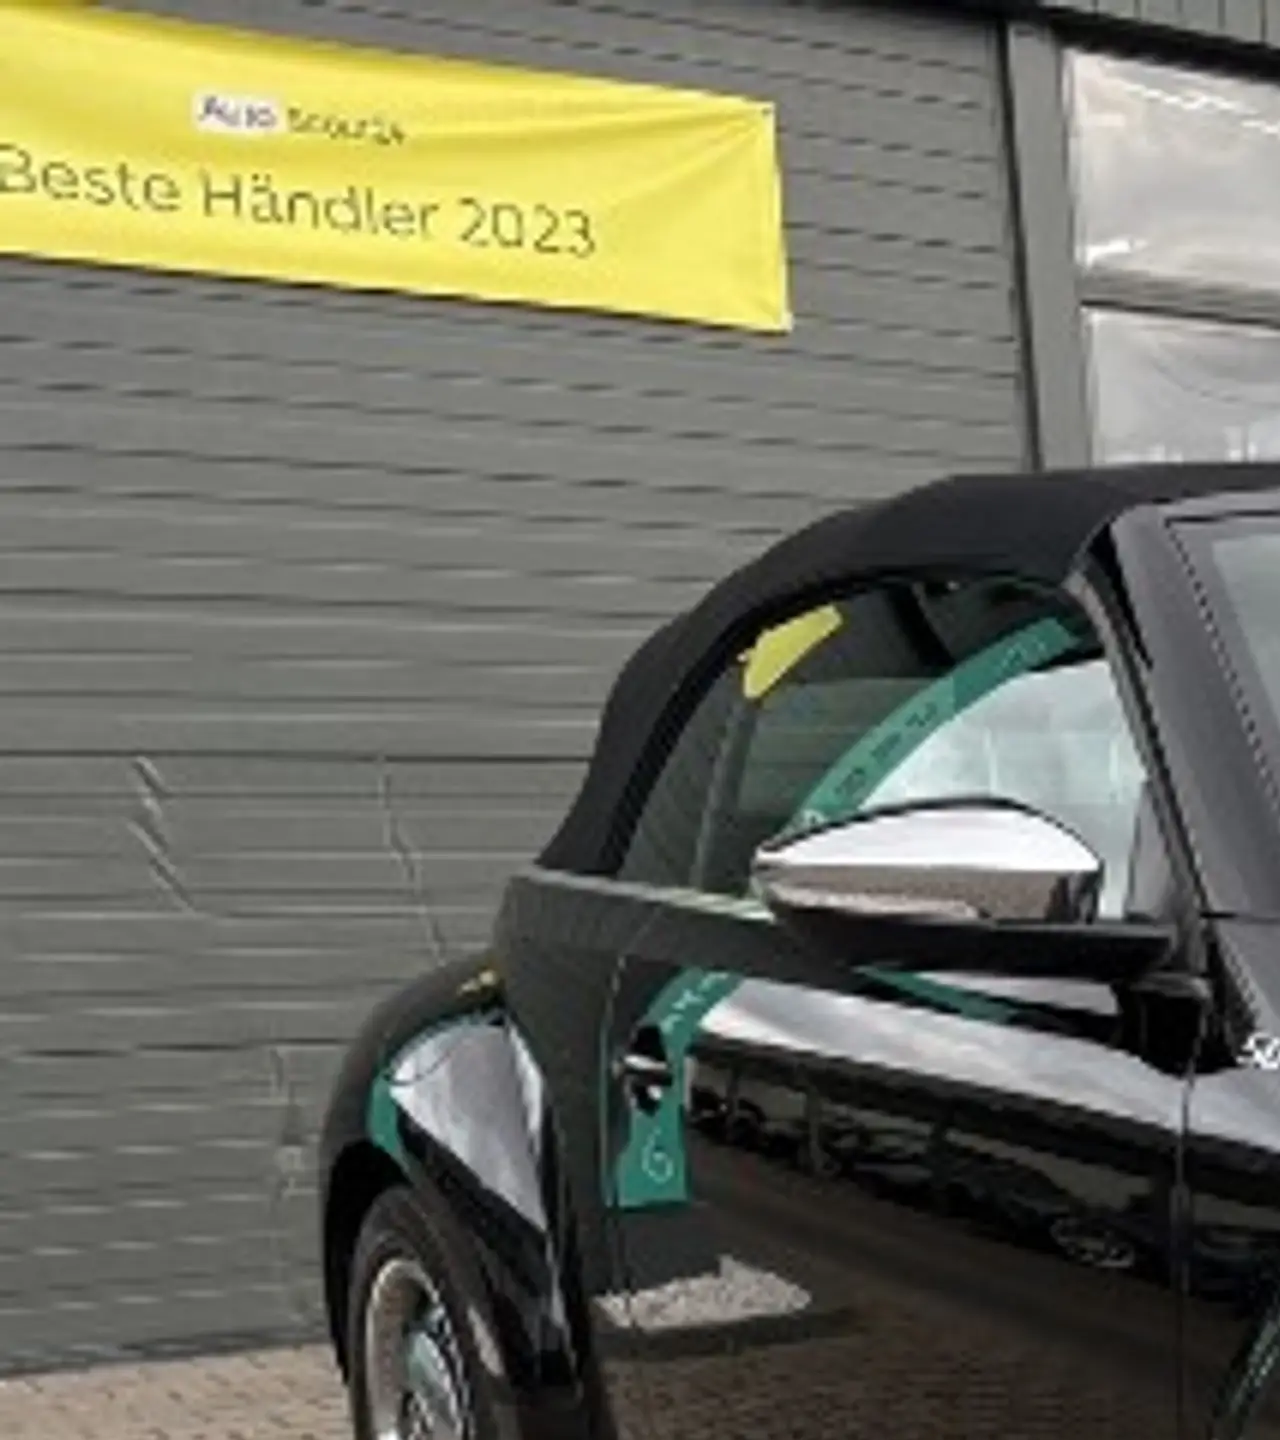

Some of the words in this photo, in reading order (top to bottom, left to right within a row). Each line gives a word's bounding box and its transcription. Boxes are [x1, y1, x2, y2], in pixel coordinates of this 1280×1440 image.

[0, 142, 182, 213] Beste
[201, 171, 439, 238] Händler
[460, 196, 598, 258] 2023
